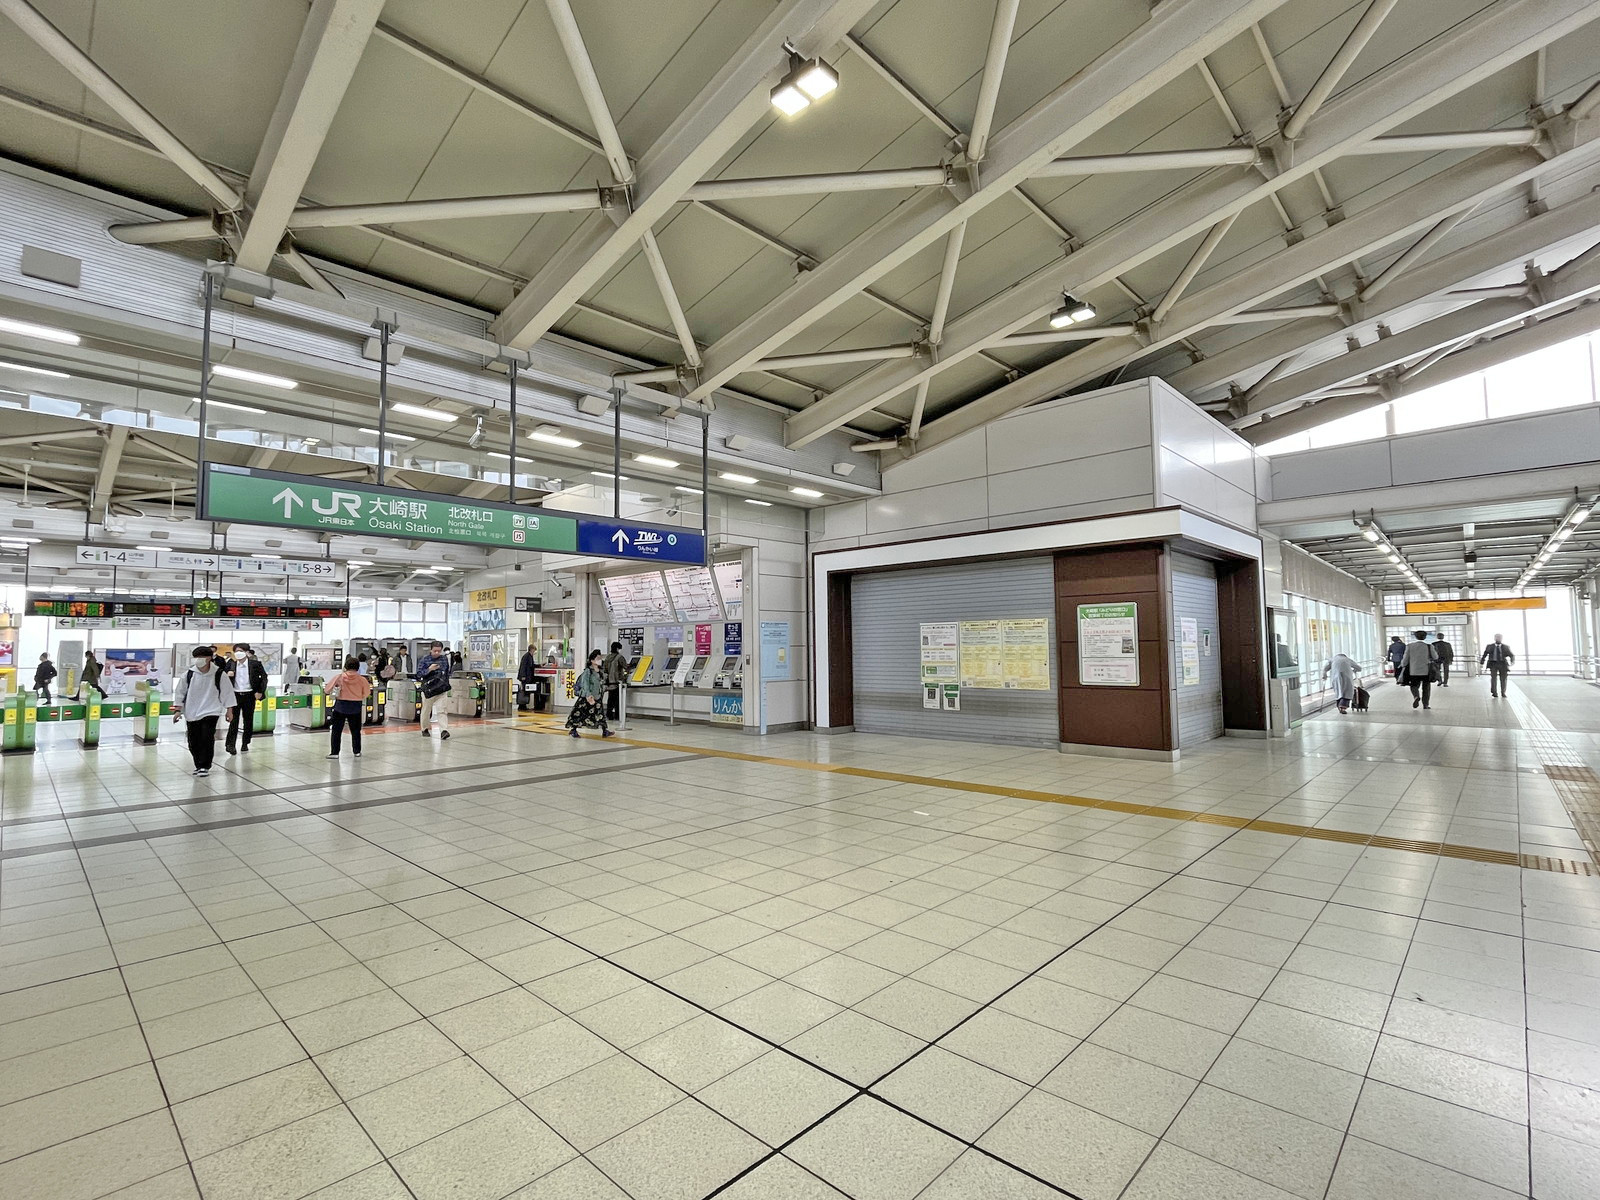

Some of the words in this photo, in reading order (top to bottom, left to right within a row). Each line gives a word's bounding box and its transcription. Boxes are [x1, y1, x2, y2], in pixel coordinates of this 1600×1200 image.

[312, 491, 361, 518] JR
[368, 497, 427, 520] 大崎駅
[318, 516, 355, 526] JR東日本
[448, 506, 493, 522] 北改札口
[405, 521, 443, 535] Station
[447, 519, 467, 529] North
[468, 523, 485, 531] Gate
[638, 531, 658, 541] TWR
